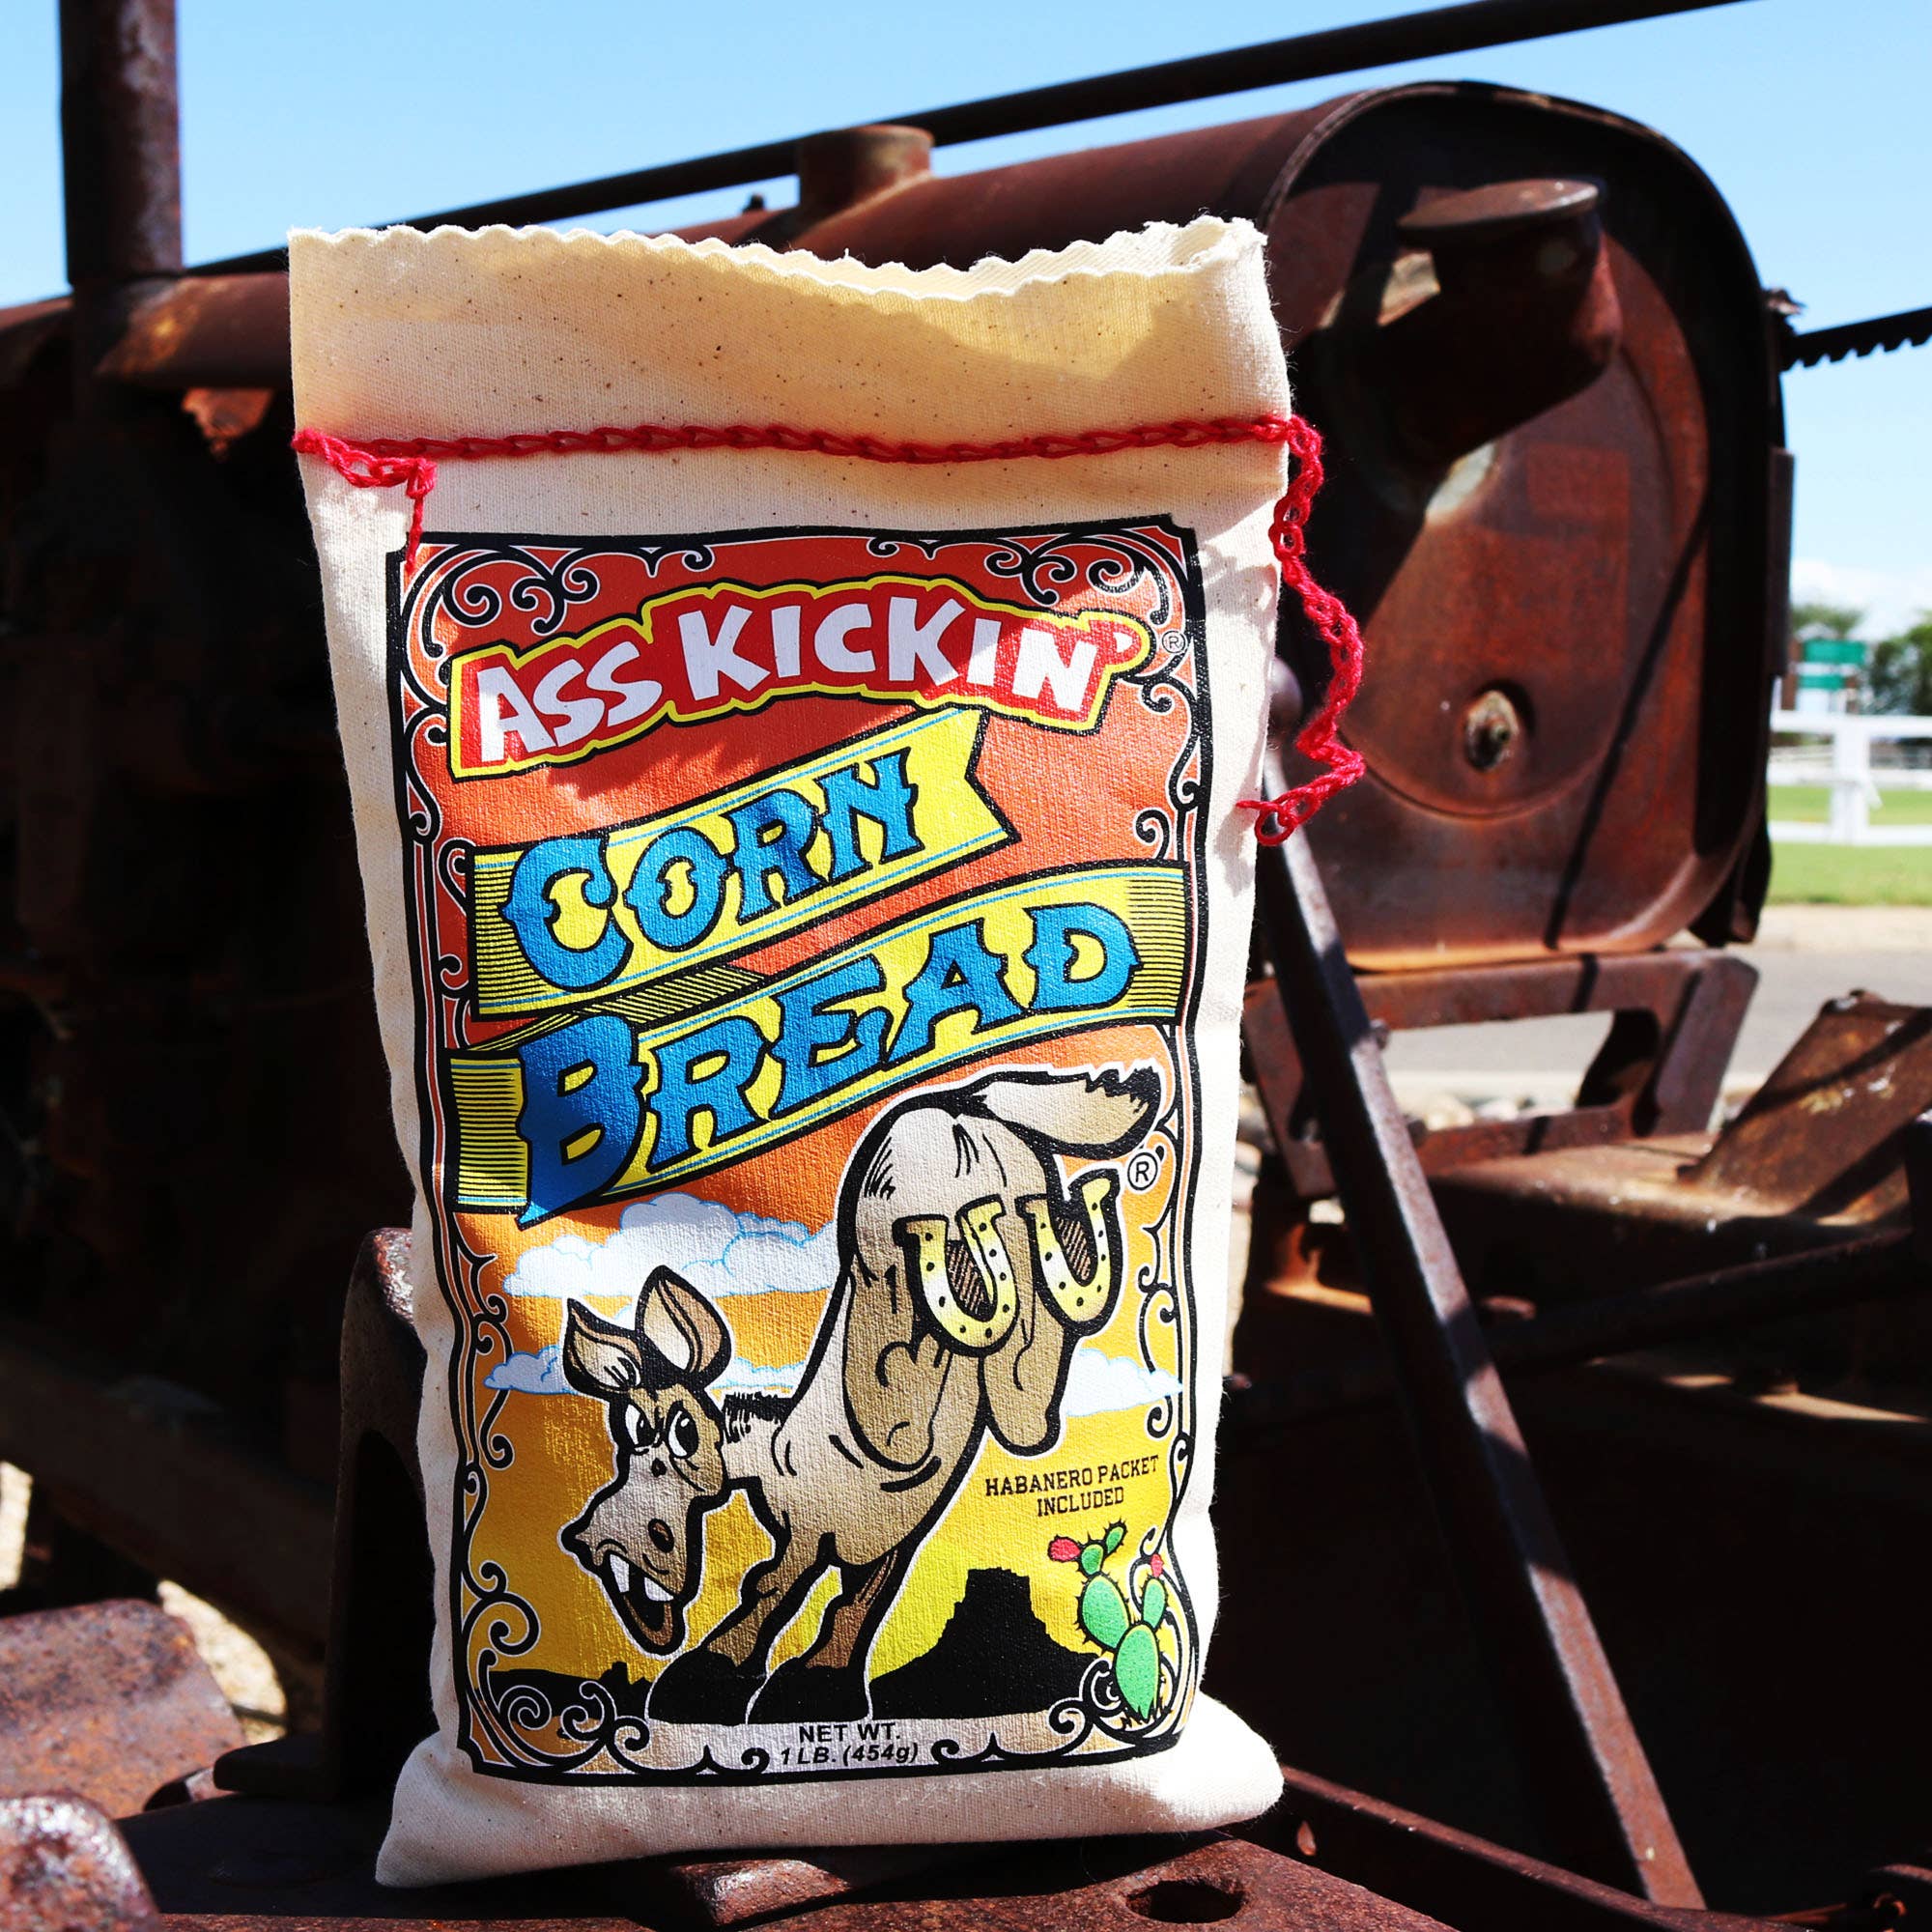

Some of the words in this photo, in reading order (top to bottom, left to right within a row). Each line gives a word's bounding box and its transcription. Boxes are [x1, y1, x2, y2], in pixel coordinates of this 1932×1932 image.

[476, 640, 664, 763] ASS
[499, 750, 921, 994] CORN
[516, 898, 1143, 1232] BREAD
[985, 1466, 1093, 1497] HABANERO
[1097, 1454, 1159, 1484] PACKET
[1037, 1486, 1125, 1518] INCLUDED
[799, 1724, 848, 1743] NET
[858, 1722, 901, 1741] WT.
[781, 1747, 790, 1765] 1
[797, 1747, 837, 1765] LB.
[842, 1742, 919, 1767] (454g)
